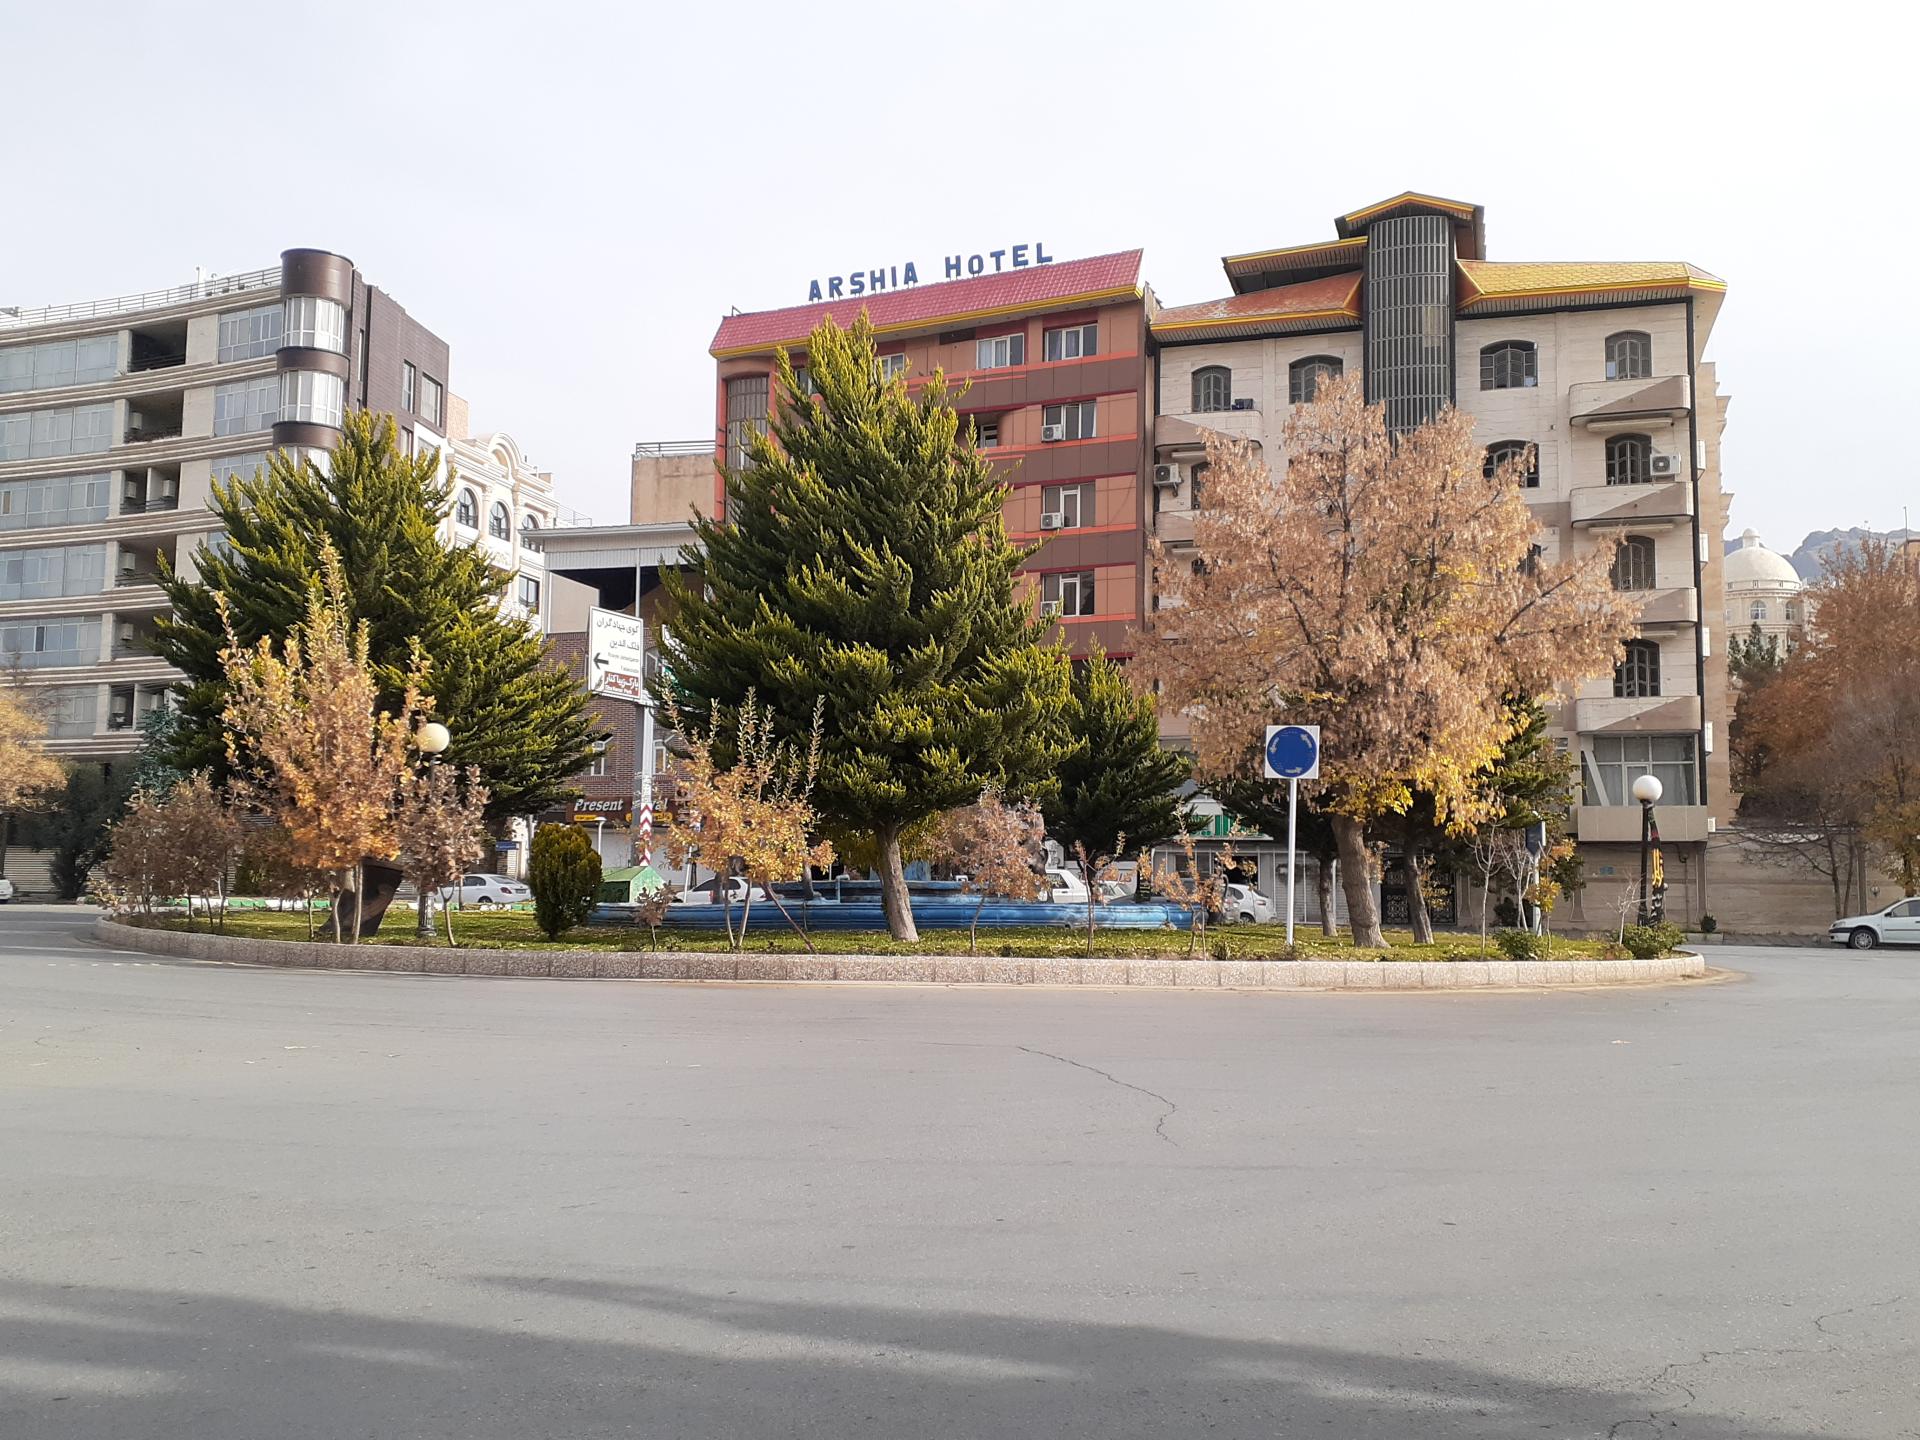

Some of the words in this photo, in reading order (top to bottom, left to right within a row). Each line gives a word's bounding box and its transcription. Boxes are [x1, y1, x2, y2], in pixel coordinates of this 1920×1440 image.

[809, 261, 918, 301] ARSHIA
[945, 243, 1053, 278] HOTEL
[574, 798, 624, 811] Present
